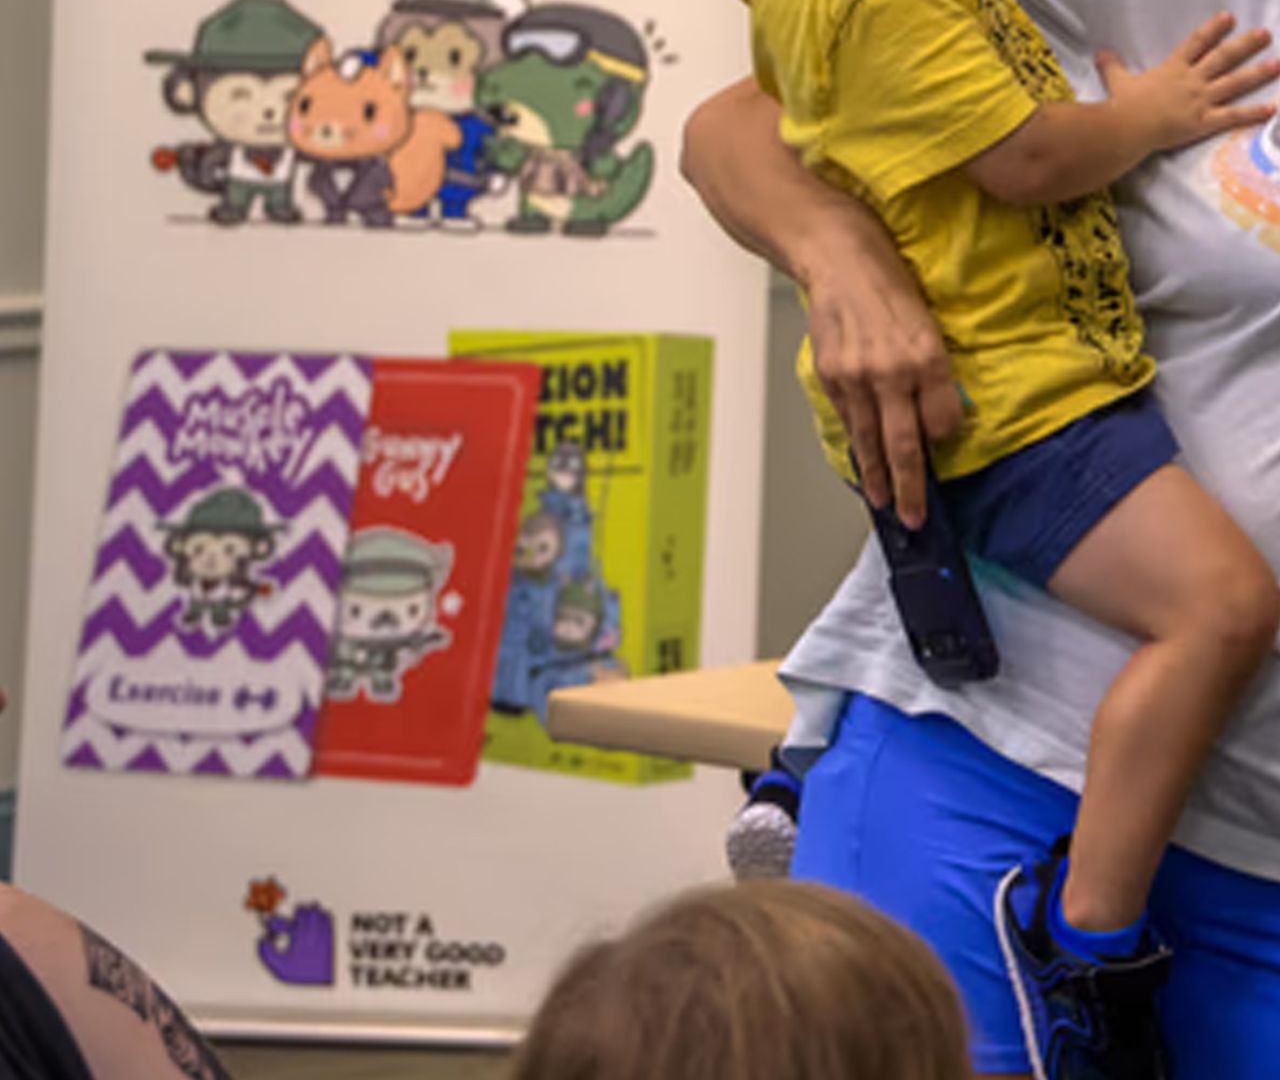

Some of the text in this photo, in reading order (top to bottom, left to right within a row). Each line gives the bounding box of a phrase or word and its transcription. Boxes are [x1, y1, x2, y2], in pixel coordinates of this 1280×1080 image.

[351, 913, 433, 935] NOT A
[350, 938, 506, 967] VERY GOOD
[350, 965, 471, 990] TEACHER
